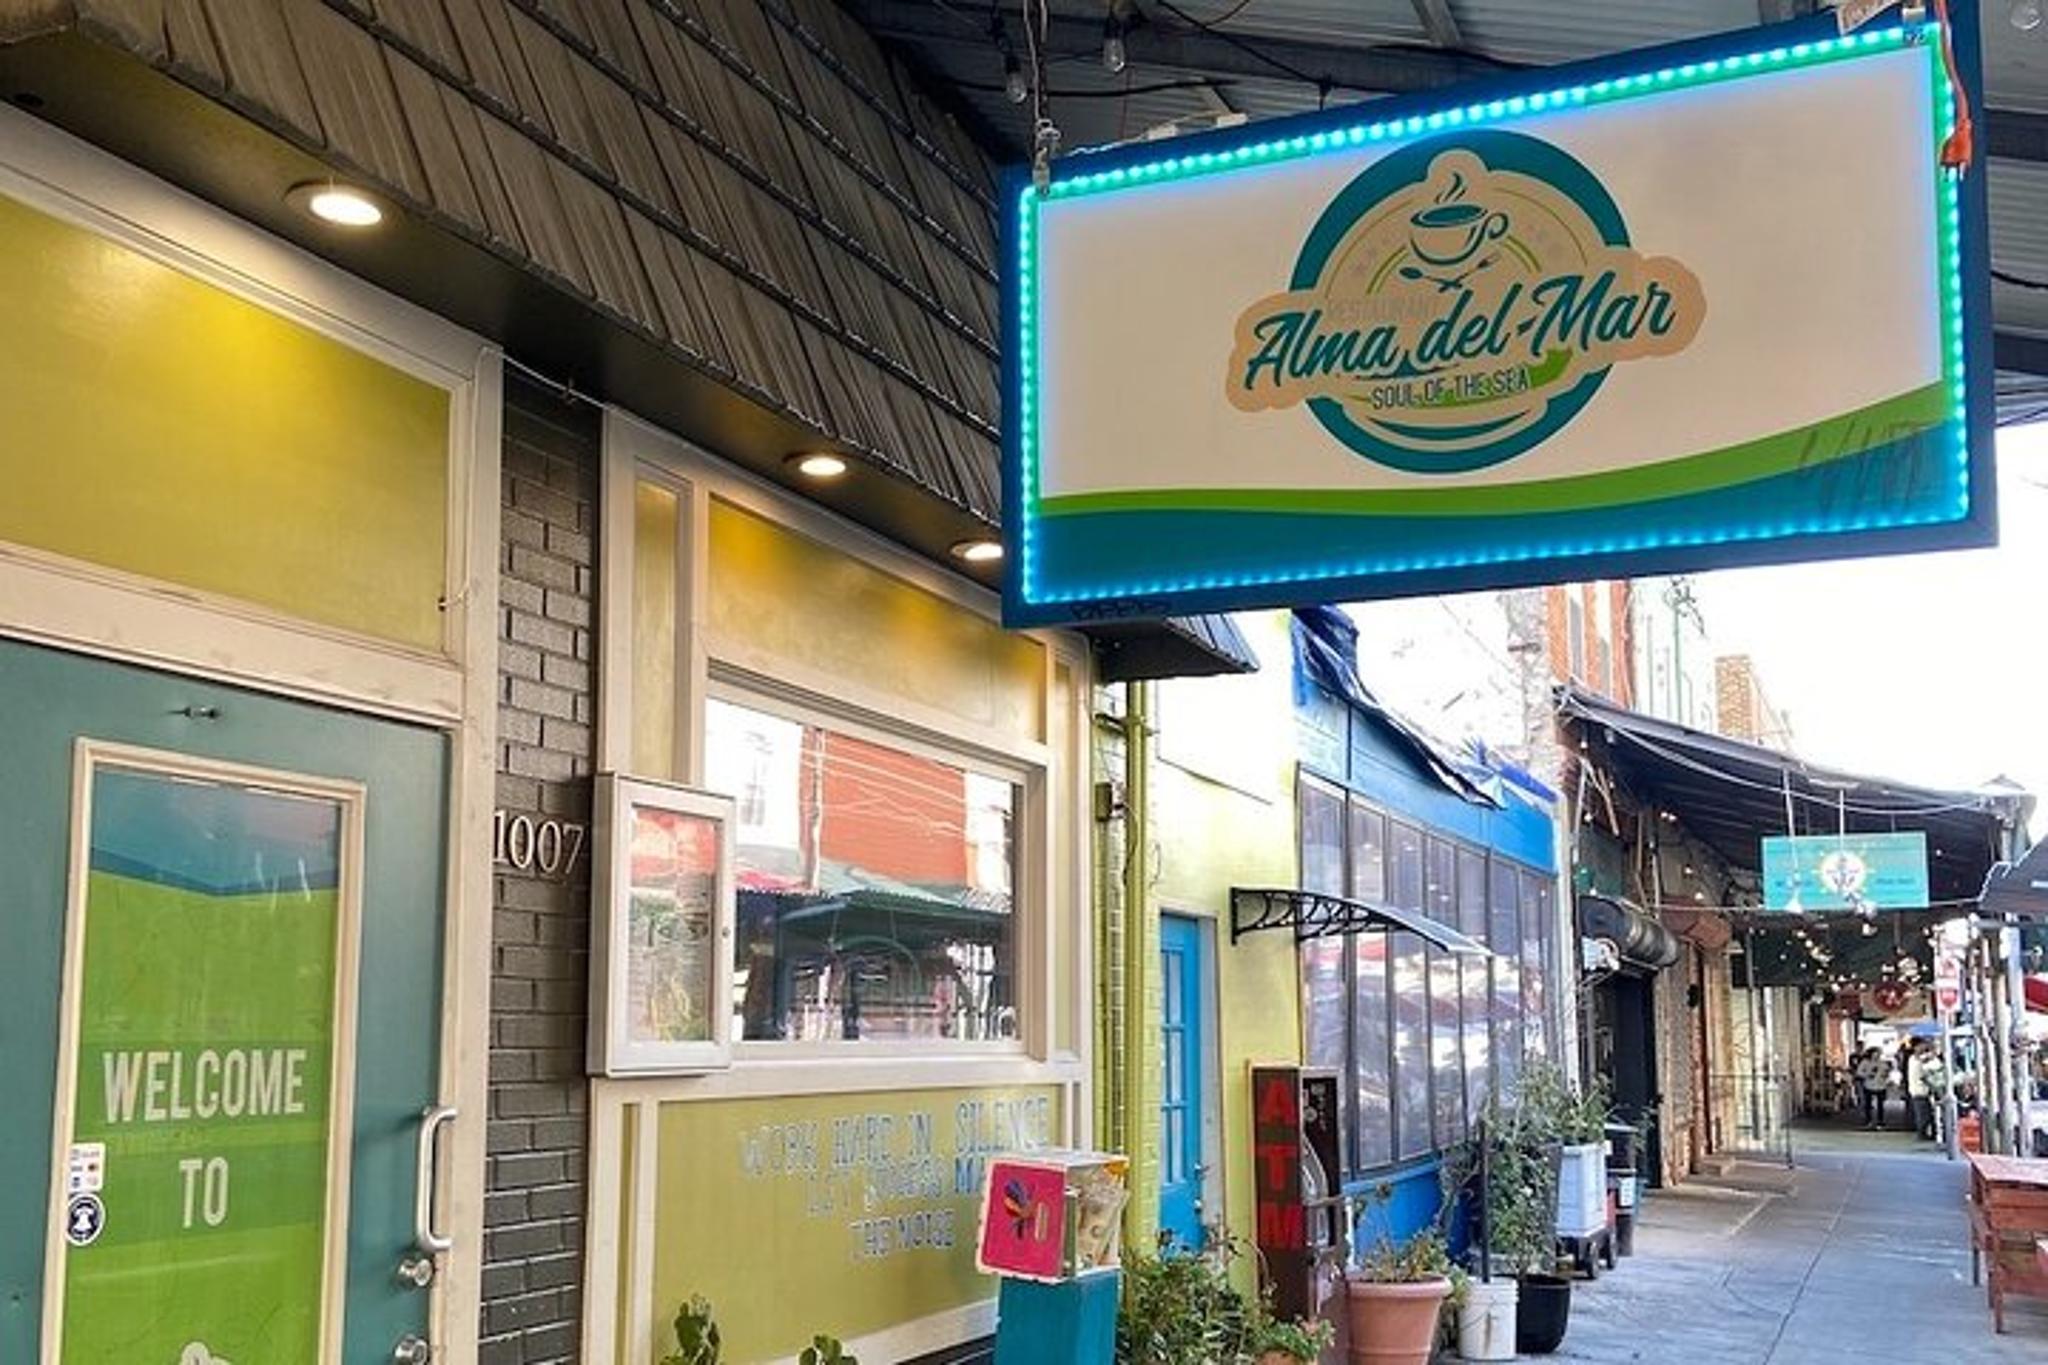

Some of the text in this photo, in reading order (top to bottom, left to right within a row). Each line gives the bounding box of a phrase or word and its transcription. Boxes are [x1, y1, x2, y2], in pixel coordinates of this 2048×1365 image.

[1245, 309, 1402, 391] Alma
[1418, 283, 1512, 361] del
[1371, 364, 1531, 409] SOUL OF THE SEA
[493, 810, 584, 875] 1007
[103, 1049, 308, 1124] WELCOME
[907, 1110, 933, 1154] IN
[954, 1097, 1048, 1152] SILENCE
[178, 1156, 230, 1229] TO
[1254, 1079, 1305, 1250] ATM
